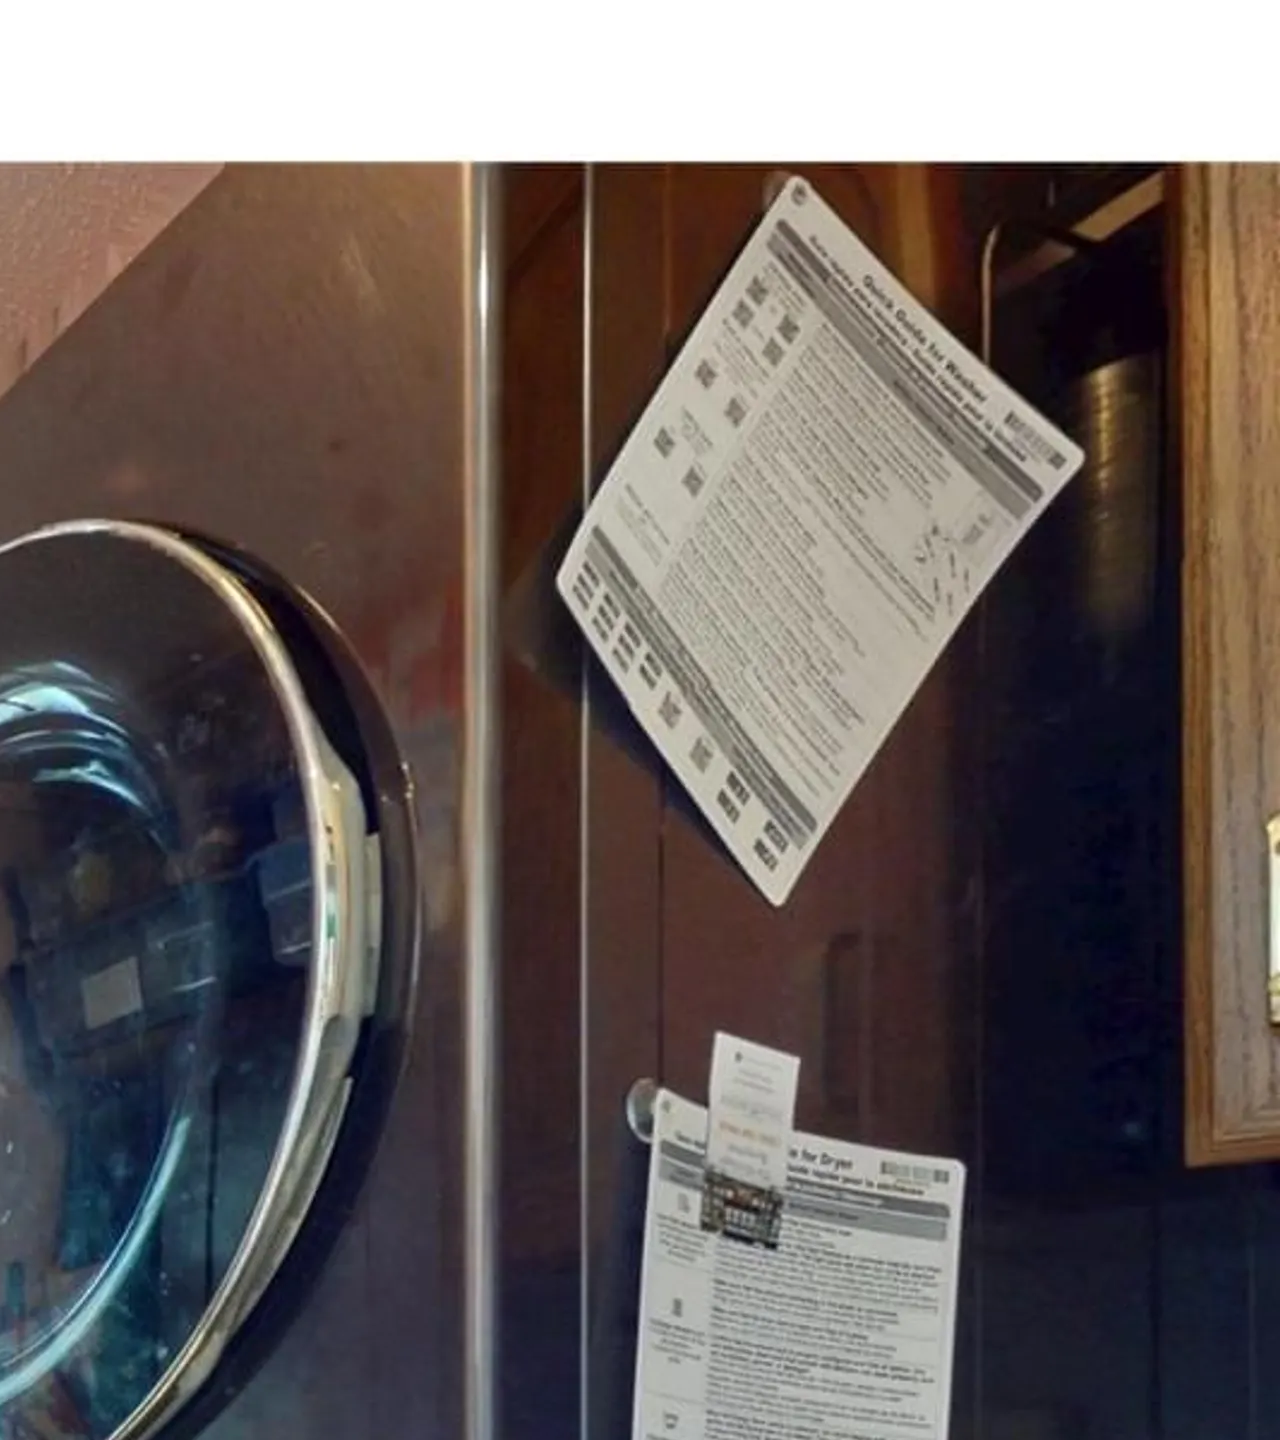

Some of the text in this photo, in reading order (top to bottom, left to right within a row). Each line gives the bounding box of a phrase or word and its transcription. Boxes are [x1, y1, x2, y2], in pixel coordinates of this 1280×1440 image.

[863, 275, 988, 402] Quick Guide for Washer
[801, 1148, 818, 1162] for
